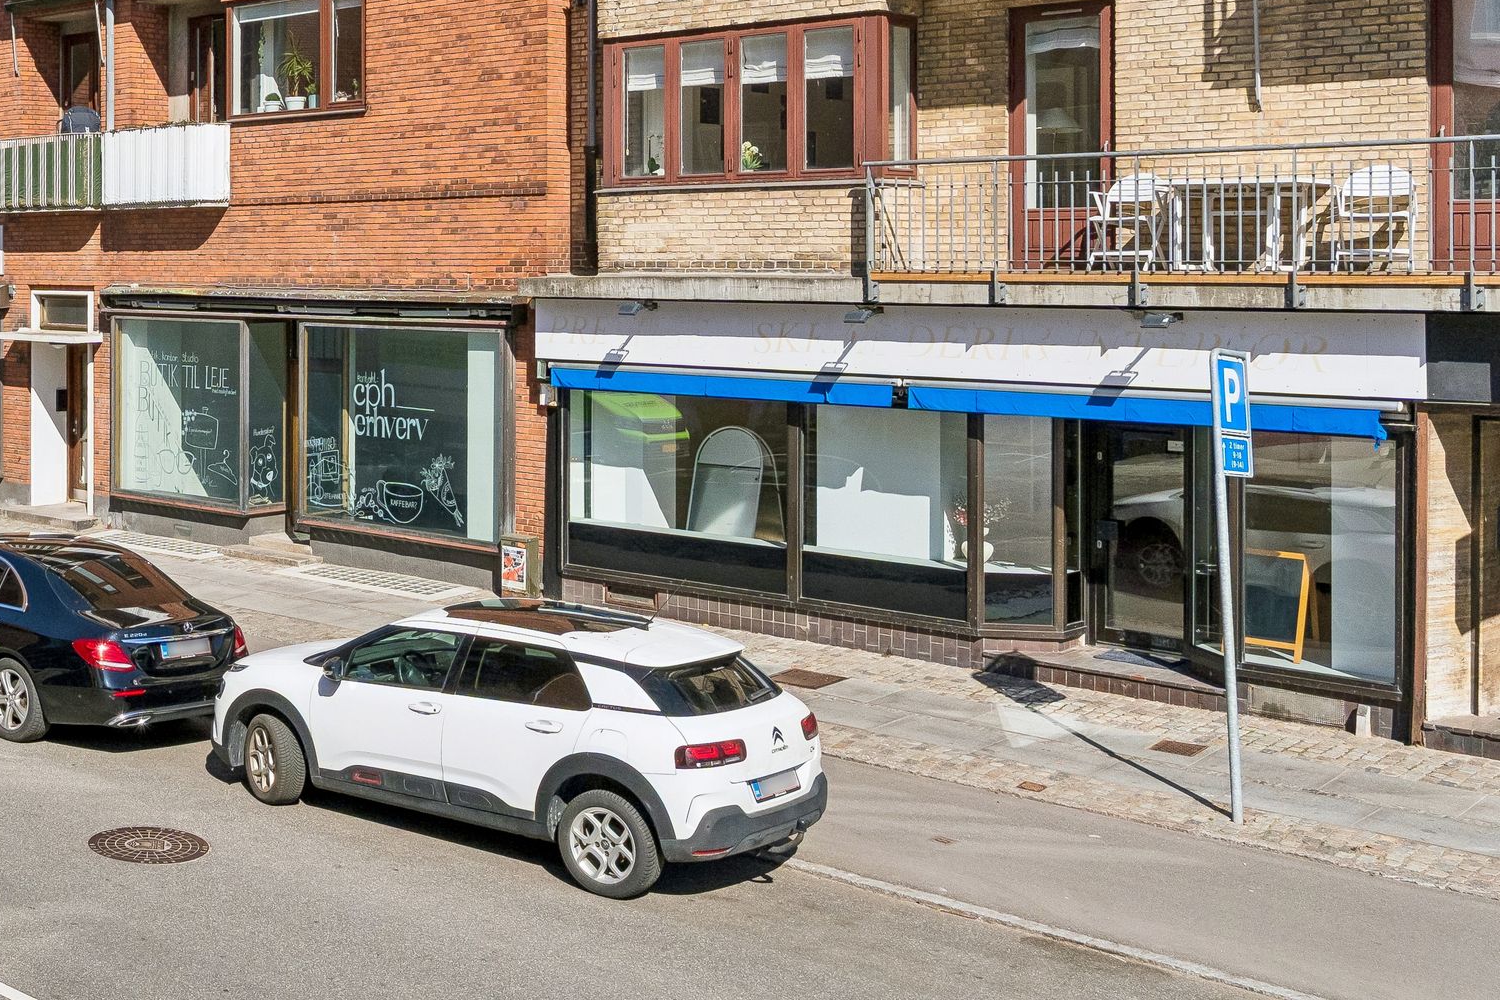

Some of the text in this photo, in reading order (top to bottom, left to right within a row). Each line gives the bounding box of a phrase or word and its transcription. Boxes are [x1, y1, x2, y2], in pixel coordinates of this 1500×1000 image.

[140, 360, 230, 389] BUTIK TIL LEJE
[353, 368, 395, 415] cph
[1223, 367, 1241, 423] P
[354, 406, 430, 441] erhverv
[1229, 441, 1245, 451] 2 timer
